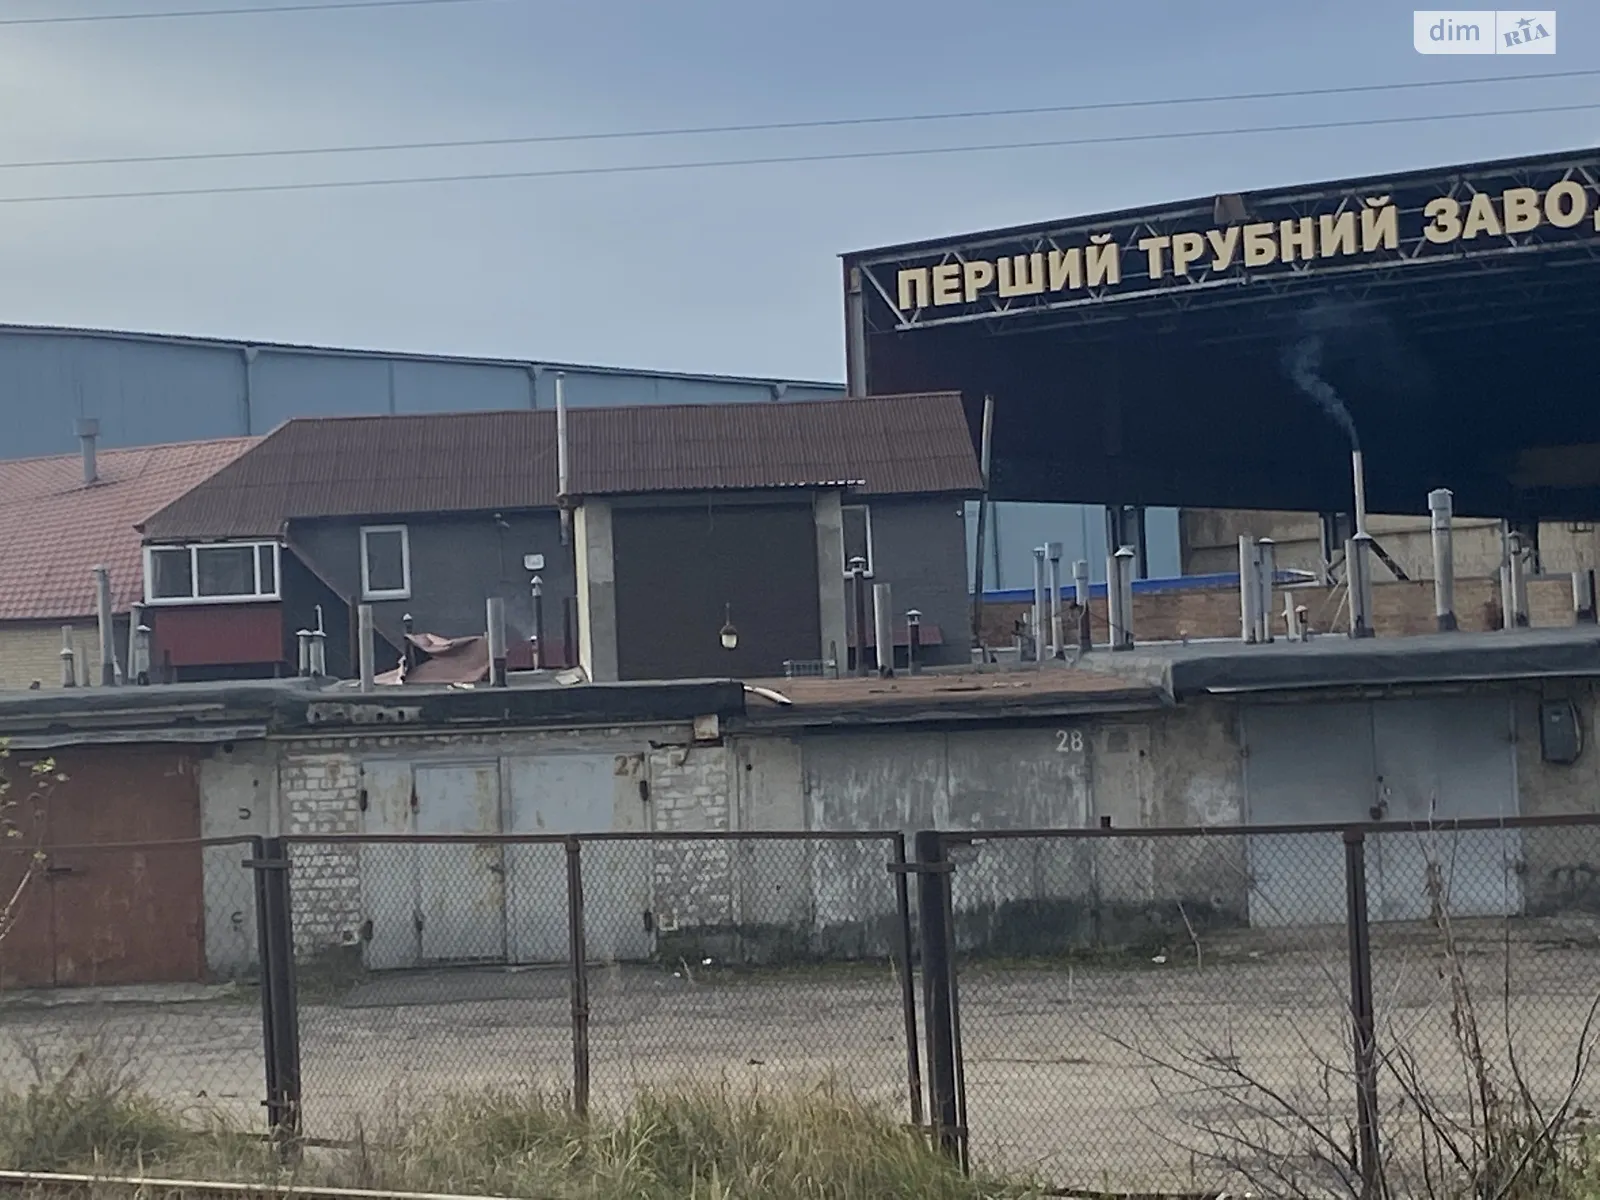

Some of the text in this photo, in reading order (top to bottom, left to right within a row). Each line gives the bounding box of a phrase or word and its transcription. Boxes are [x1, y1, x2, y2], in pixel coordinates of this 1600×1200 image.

[898, 180, 1600, 310] ПЕРШИЙ ТРУБНИЙ ЗАВО
[1055, 730, 1084, 752] 28
[614, 754, 641, 776] 27
